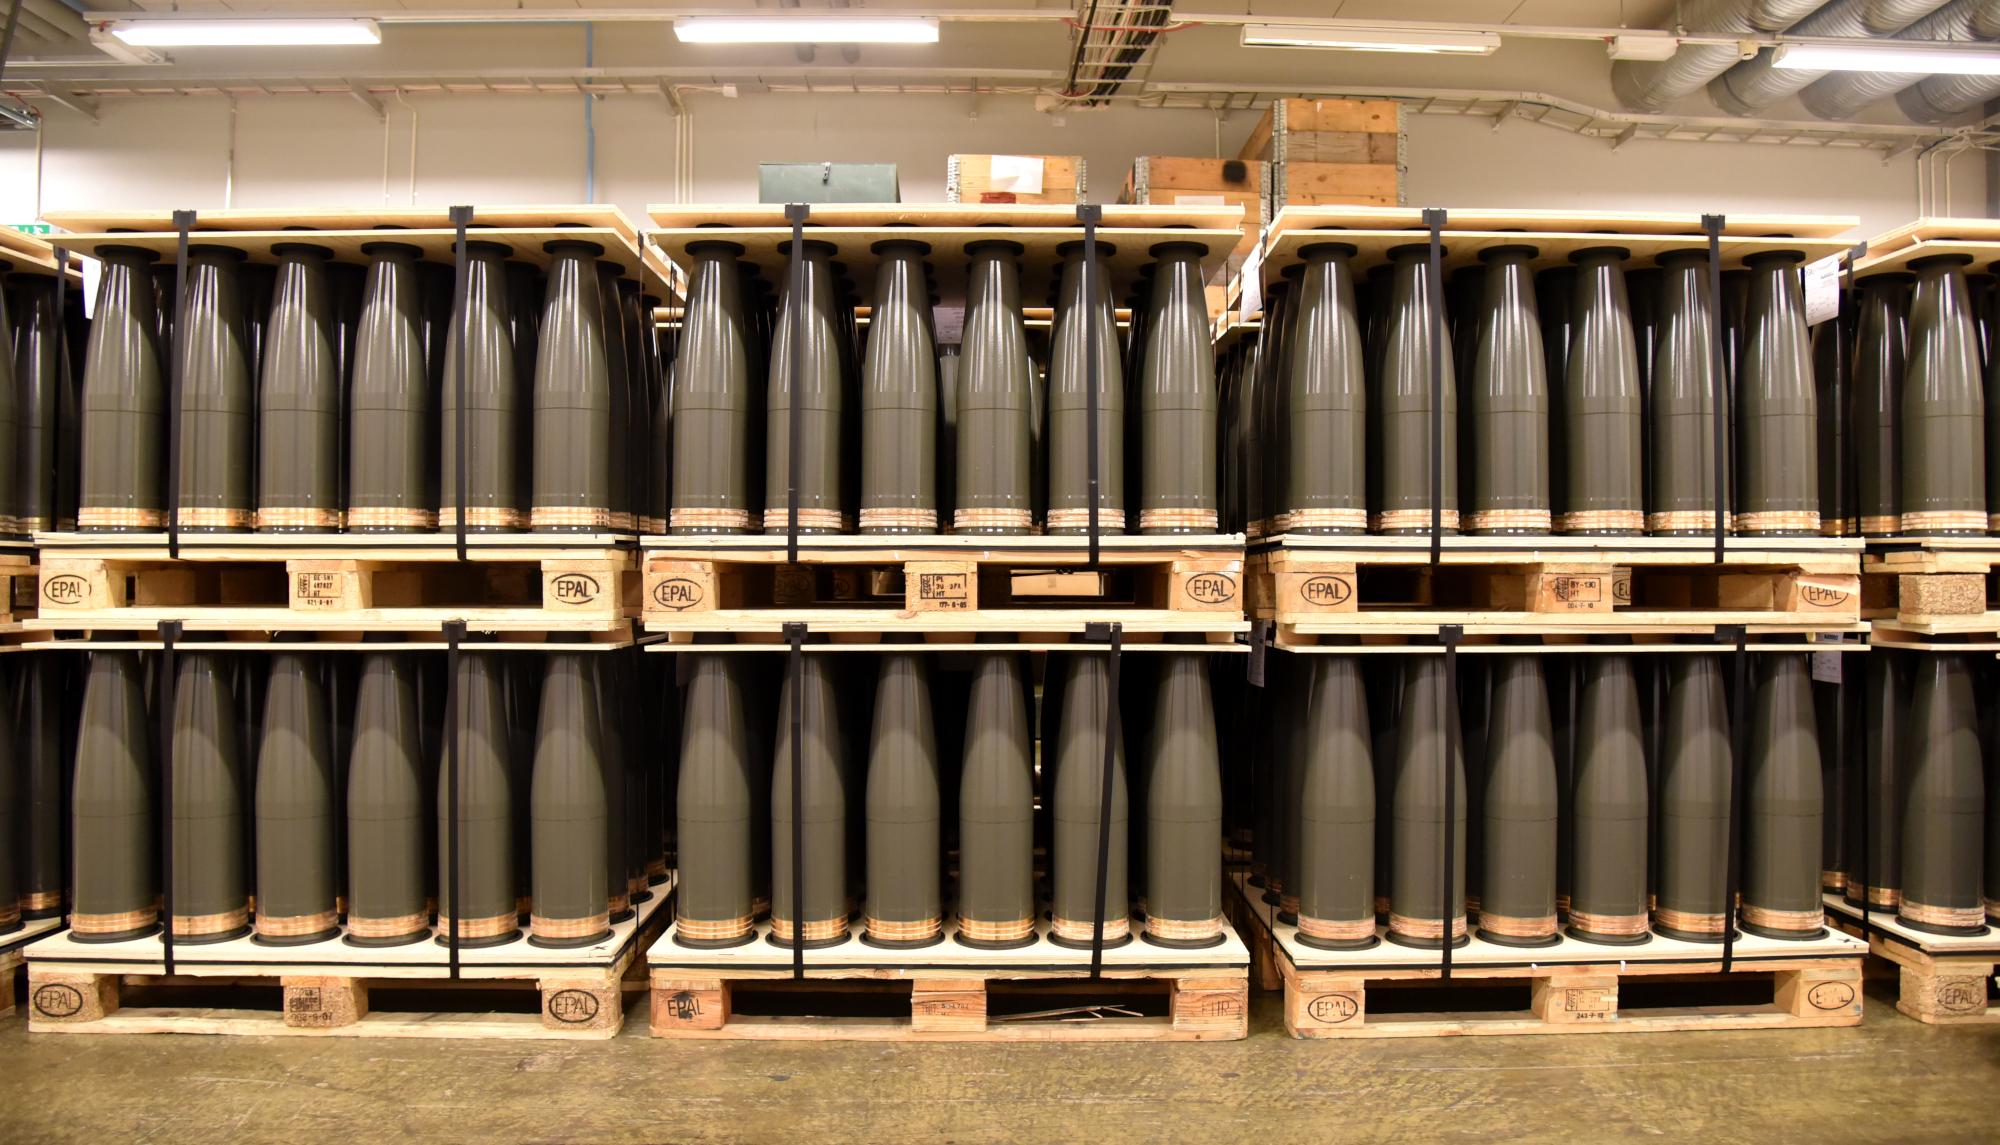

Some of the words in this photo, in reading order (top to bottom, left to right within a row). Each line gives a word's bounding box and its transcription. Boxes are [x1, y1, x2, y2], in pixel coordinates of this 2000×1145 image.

[52, 581, 82, 598] EPAL
[557, 580, 591, 598] EPAL
[662, 584, 696, 602] EPAL
[1194, 579, 1229, 597] EPAL
[1308, 582, 1344, 600] EPAL
[1808, 585, 1842, 601] EPAL
[40, 990, 78, 1010] EPAL
[556, 996, 592, 1015] EPAL
[1945, 988, 1975, 1005] EPAL
[667, 997, 705, 1019] EPAL
[1316, 1000, 1351, 1017] EPAL
